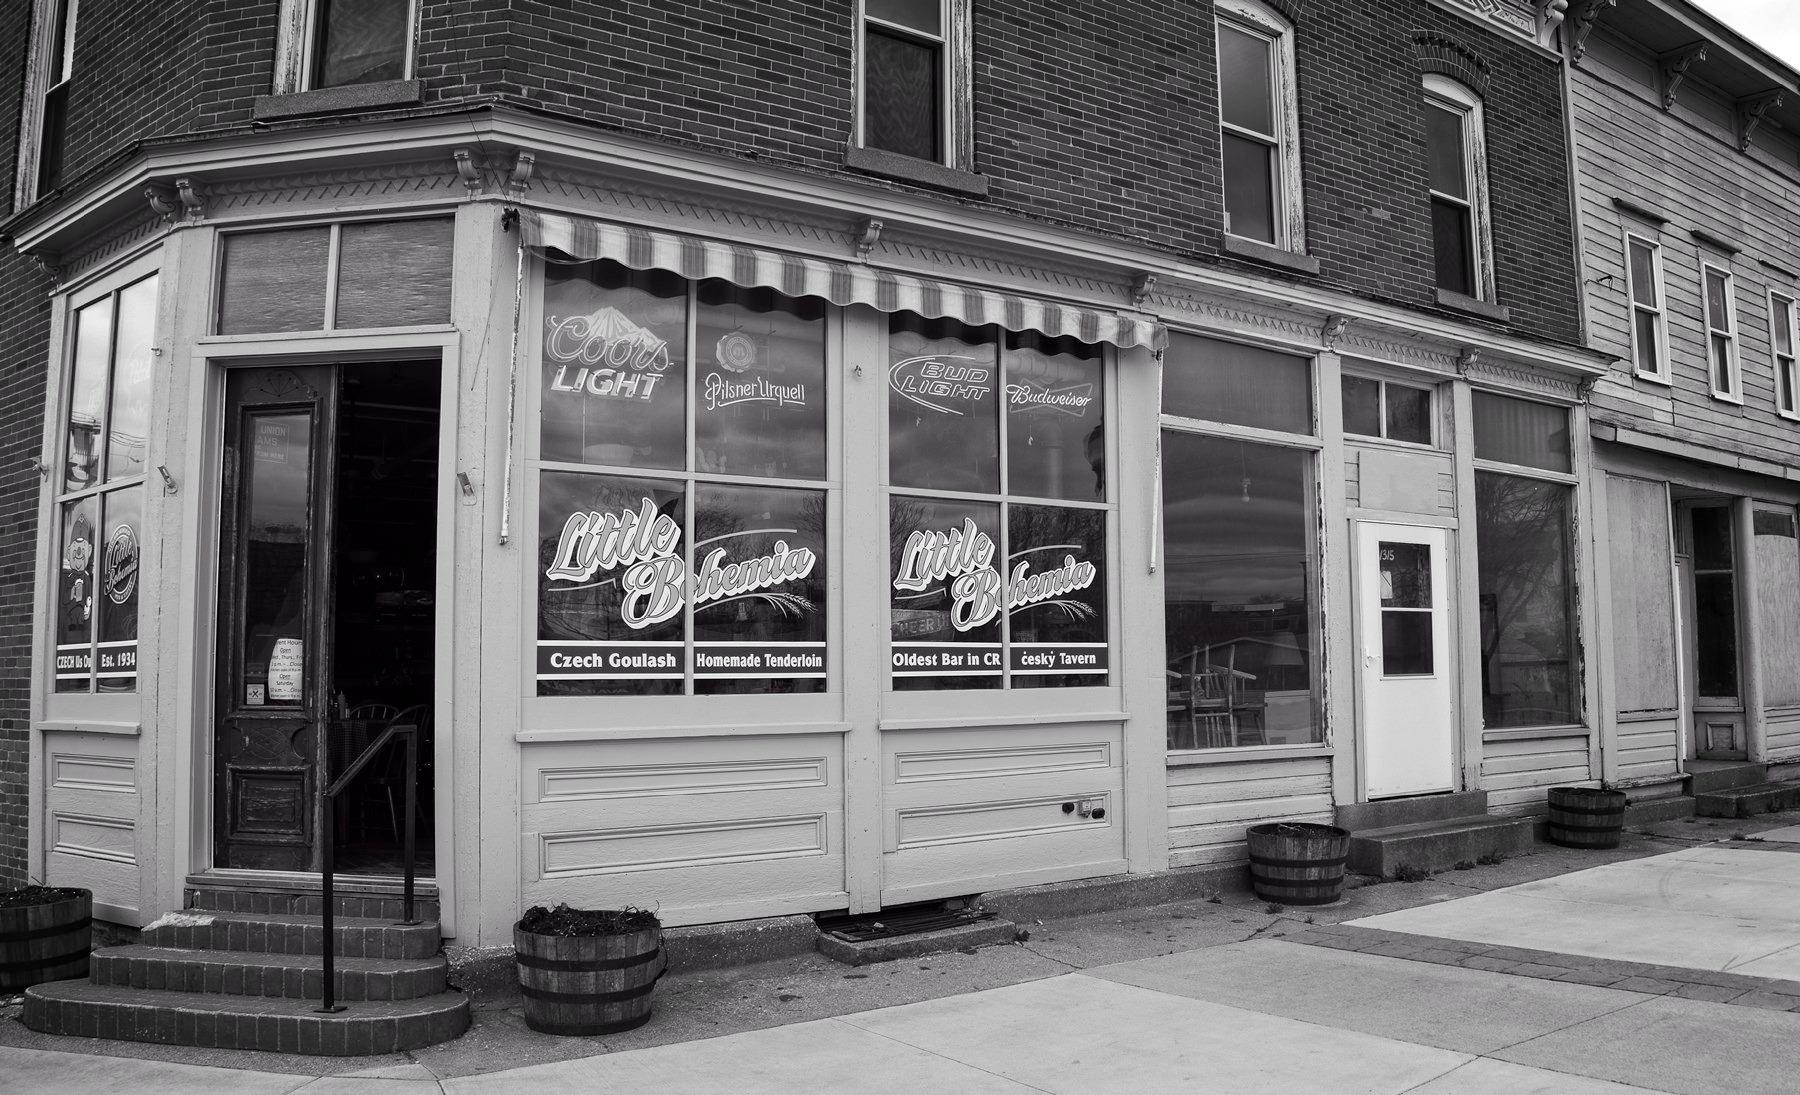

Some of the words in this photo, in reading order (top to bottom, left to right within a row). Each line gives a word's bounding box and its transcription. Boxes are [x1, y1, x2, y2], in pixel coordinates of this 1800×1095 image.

[546, 315, 670, 371] Coors
[551, 365, 664, 400] LIGHT
[921, 361, 988, 383] BUD
[705, 372, 757, 410] Pilsner
[757, 376, 805, 406] Urquell
[900, 375, 990, 400] LIGHT
[1006, 384, 1092, 407] Budweiser
[546, 497, 681, 581] Little
[893, 517, 995, 592] Little
[57, 656, 74, 669] CZECH
[101, 654, 115, 668] Est.
[117, 652, 136, 667] 1934
[550, 652, 602, 668] Czech
[609, 652, 677, 668] Goulash
[696, 653, 760, 668] Homemade
[764, 653, 822, 668] Tenderloin
[893, 653, 937, 667] Oldest
[942, 653, 964, 666] Bar
[967, 653, 980, 666] in
[983, 653, 1001, 666] CR
[1059, 652, 1097, 665] Tavern
